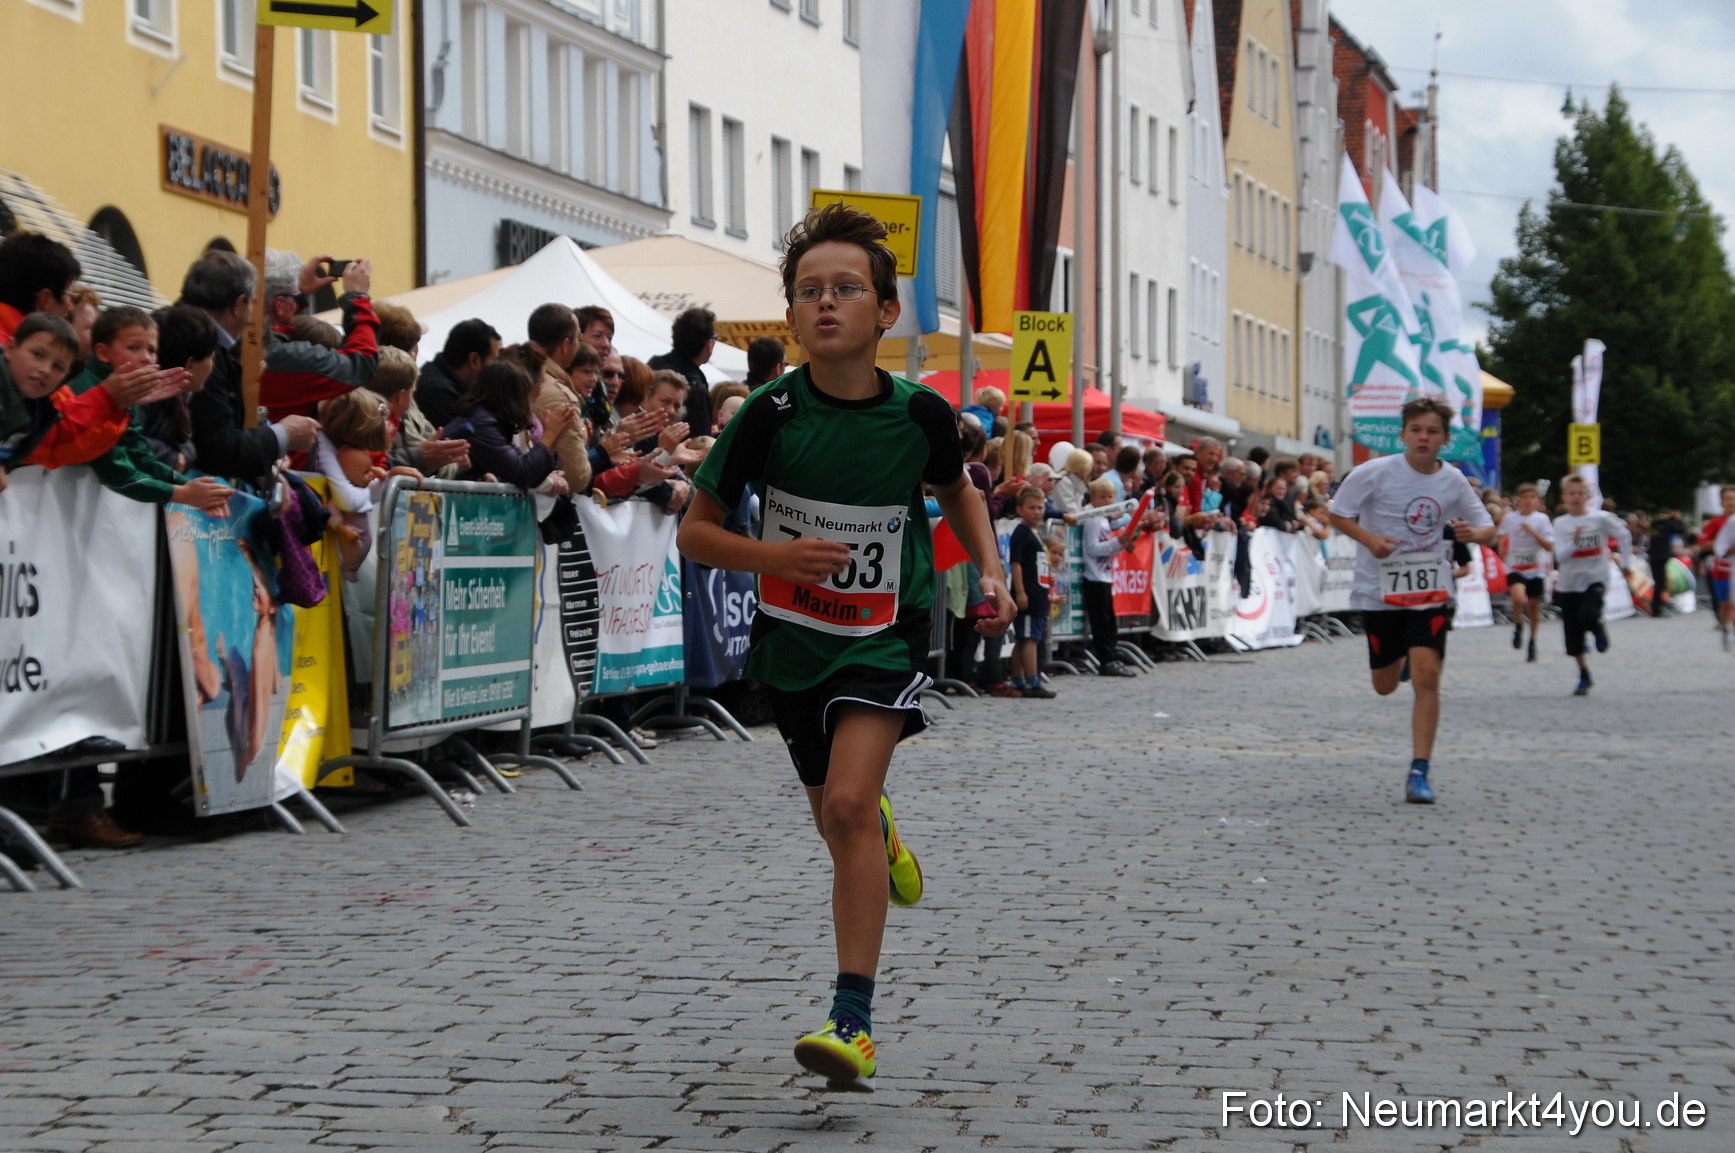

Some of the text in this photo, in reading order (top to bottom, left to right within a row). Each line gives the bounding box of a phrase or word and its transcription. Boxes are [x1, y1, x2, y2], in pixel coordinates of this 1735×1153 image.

[1020, 315, 1065, 331] Block
[1023, 339, 1056, 381] A
[1578, 436, 1592, 456] B
[768, 499, 883, 533] PARTL Neumarkt
[445, 577, 506, 611] Mehr Sicherheit
[1387, 568, 1438, 592] 7187
[791, 585, 858, 621] Maxim
[444, 623, 496, 656] für Ihr Event!
